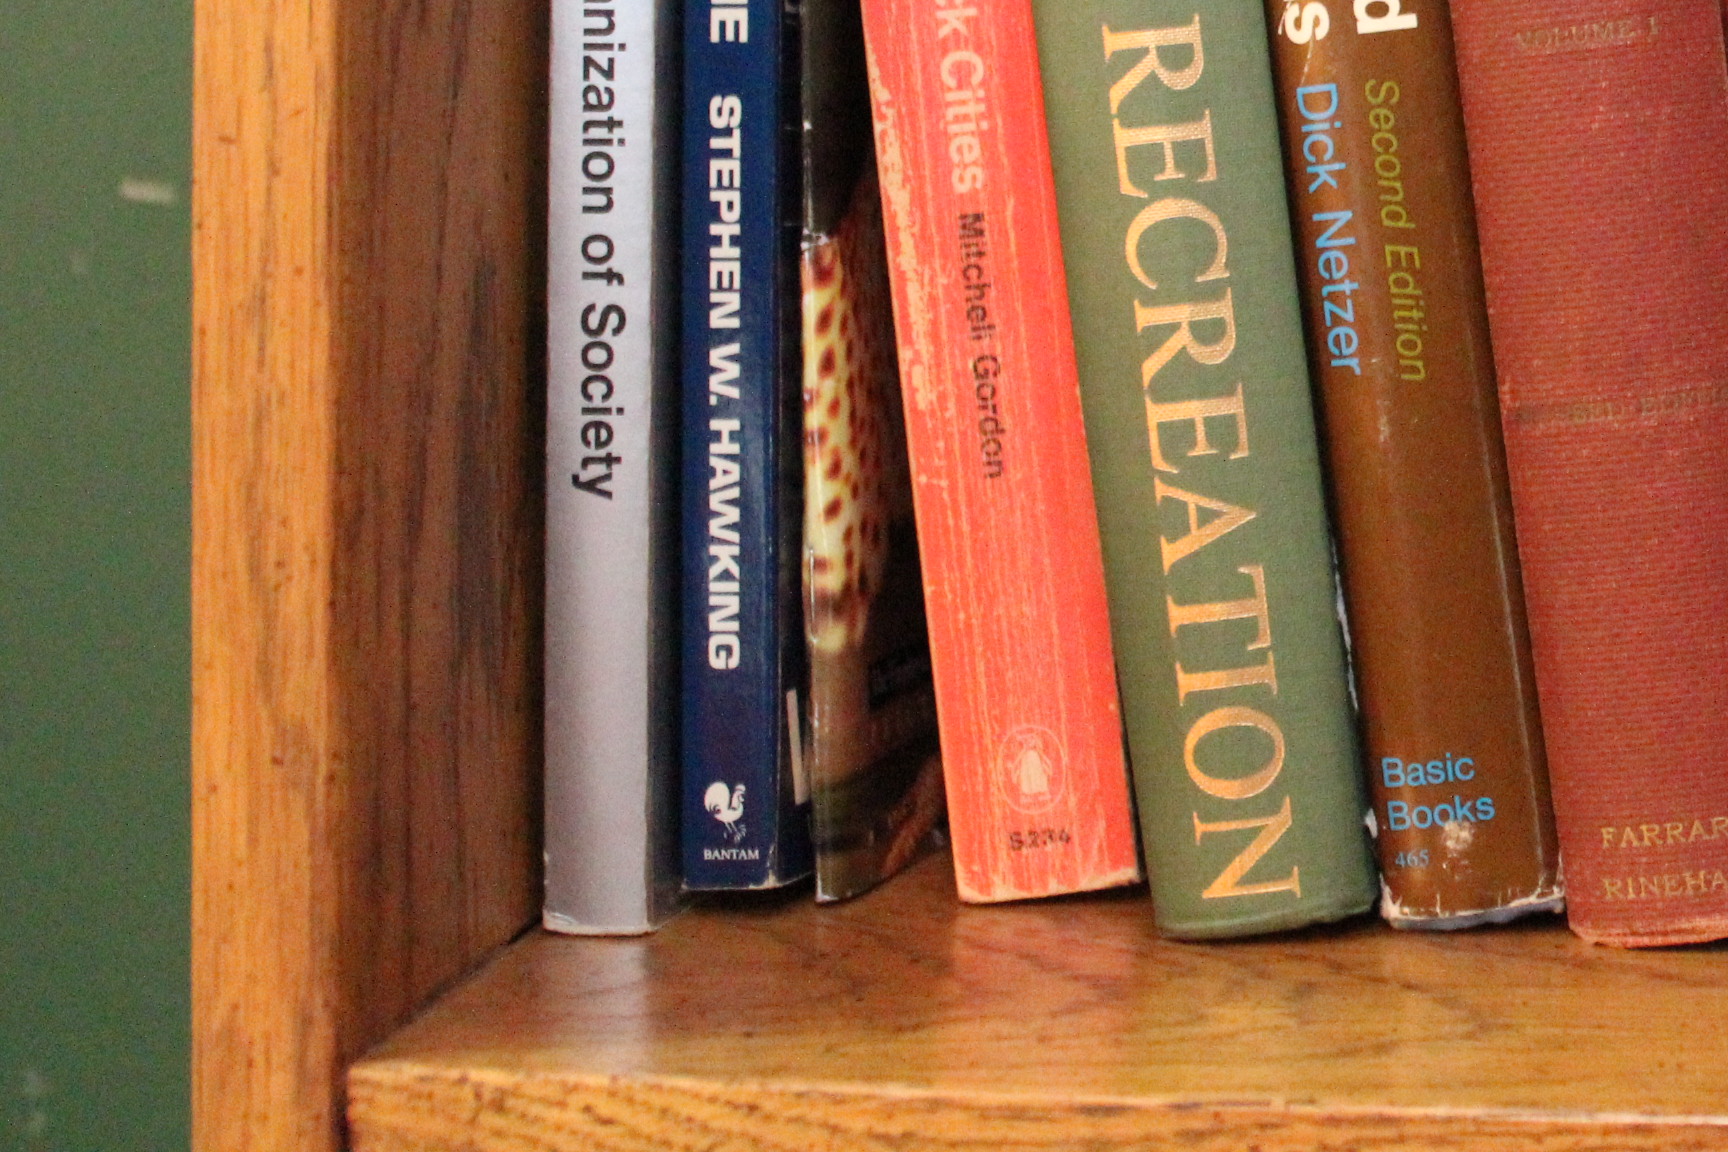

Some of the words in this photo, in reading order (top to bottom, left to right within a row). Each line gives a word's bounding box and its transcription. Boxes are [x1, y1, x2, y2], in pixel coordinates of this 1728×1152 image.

[940, 51, 987, 194] Cities
[1296, 83, 1347, 193] Dick
[1365, 79, 1415, 229] Second
[580, 245, 625, 286] of
[708, 95, 741, 328] STEPHEN
[958, 212, 997, 341] Mitchell
[1312, 211, 1361, 376] Netzer
[1385, 244, 1429, 381] Edition
[571, 303, 626, 500] Society
[708, 343, 741, 406] W.
[972, 354, 1003, 480] Gordon
[1102, 13, 1306, 901] RECREATION
[708, 419, 740, 671] HAWKING
[1382, 752, 1475, 788] Basic
[1387, 795, 1496, 831] Books
[703, 848, 759, 861] BANTAM
[1395, 849, 1429, 868] 465
